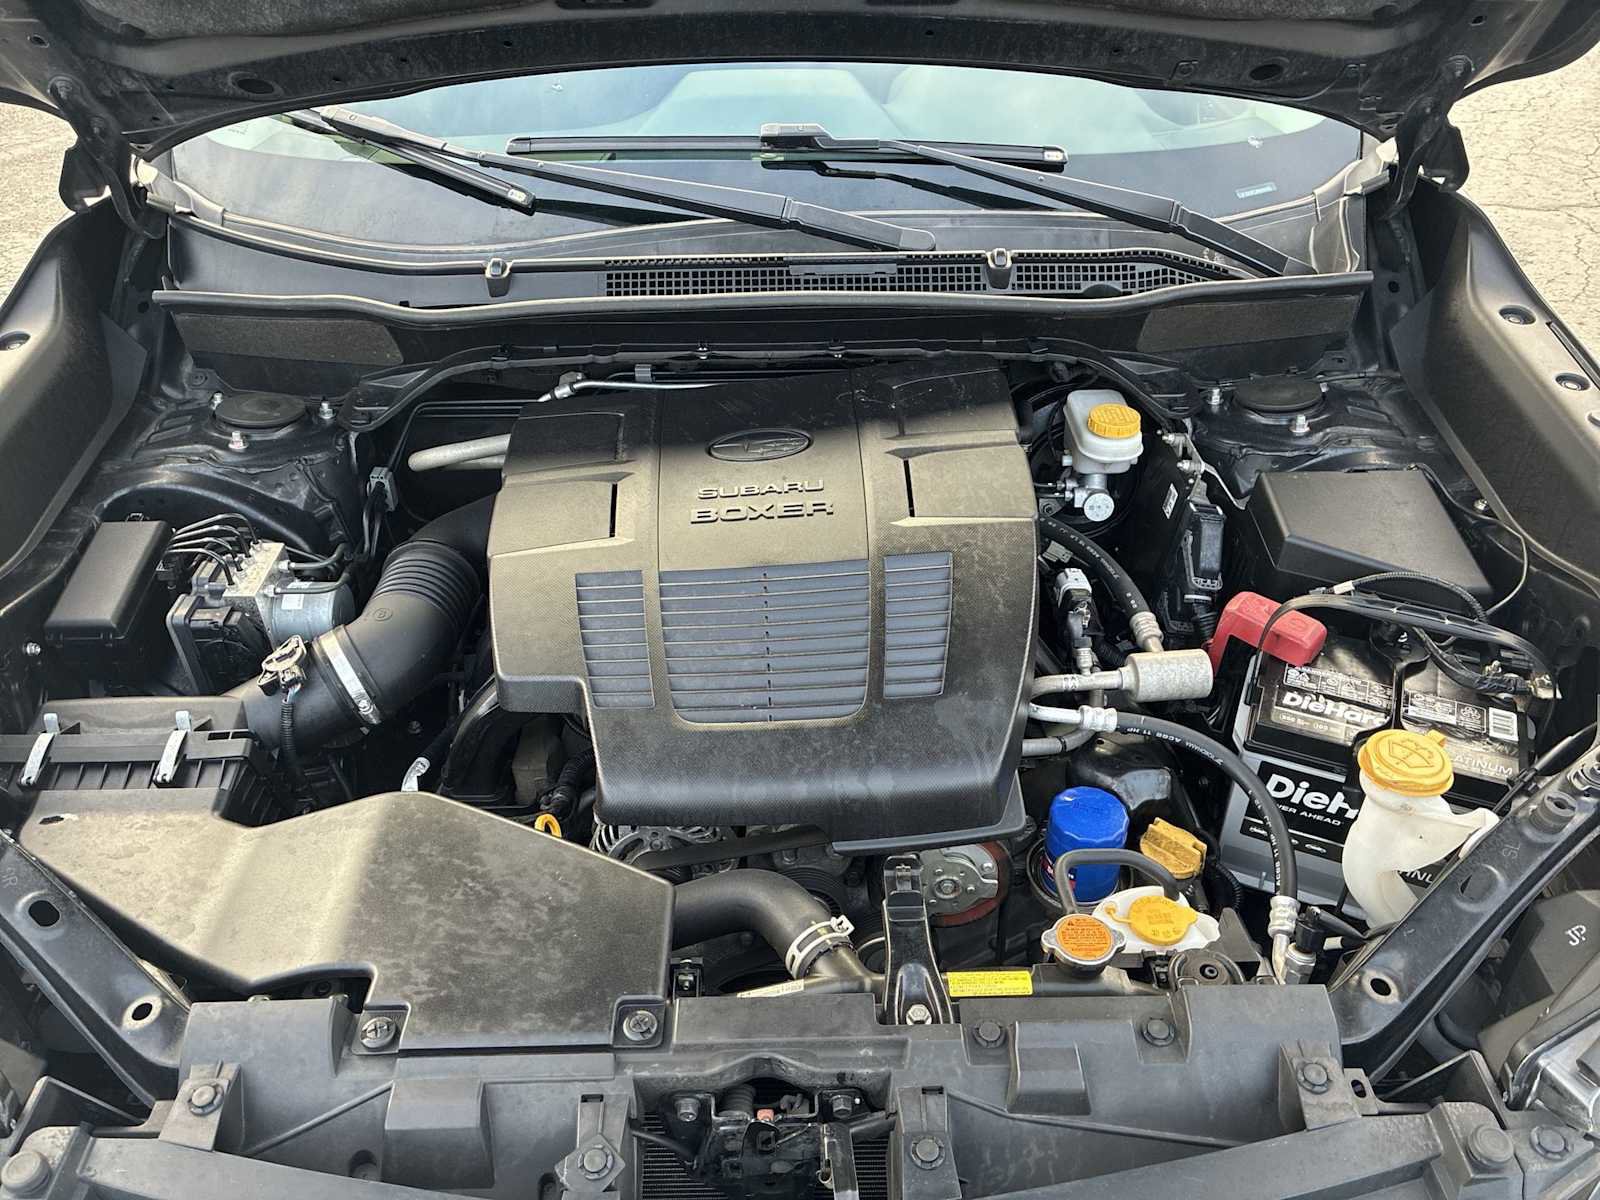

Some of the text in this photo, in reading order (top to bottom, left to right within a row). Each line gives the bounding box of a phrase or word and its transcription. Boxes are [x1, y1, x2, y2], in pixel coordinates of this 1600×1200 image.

[698, 479, 824, 500] SUBARU
[690, 503, 834, 524] BOXER
[1454, 755, 1513, 775] ATINUM
[1266, 773, 1359, 819] DieH
[1300, 811, 1341, 826] AHEAD
